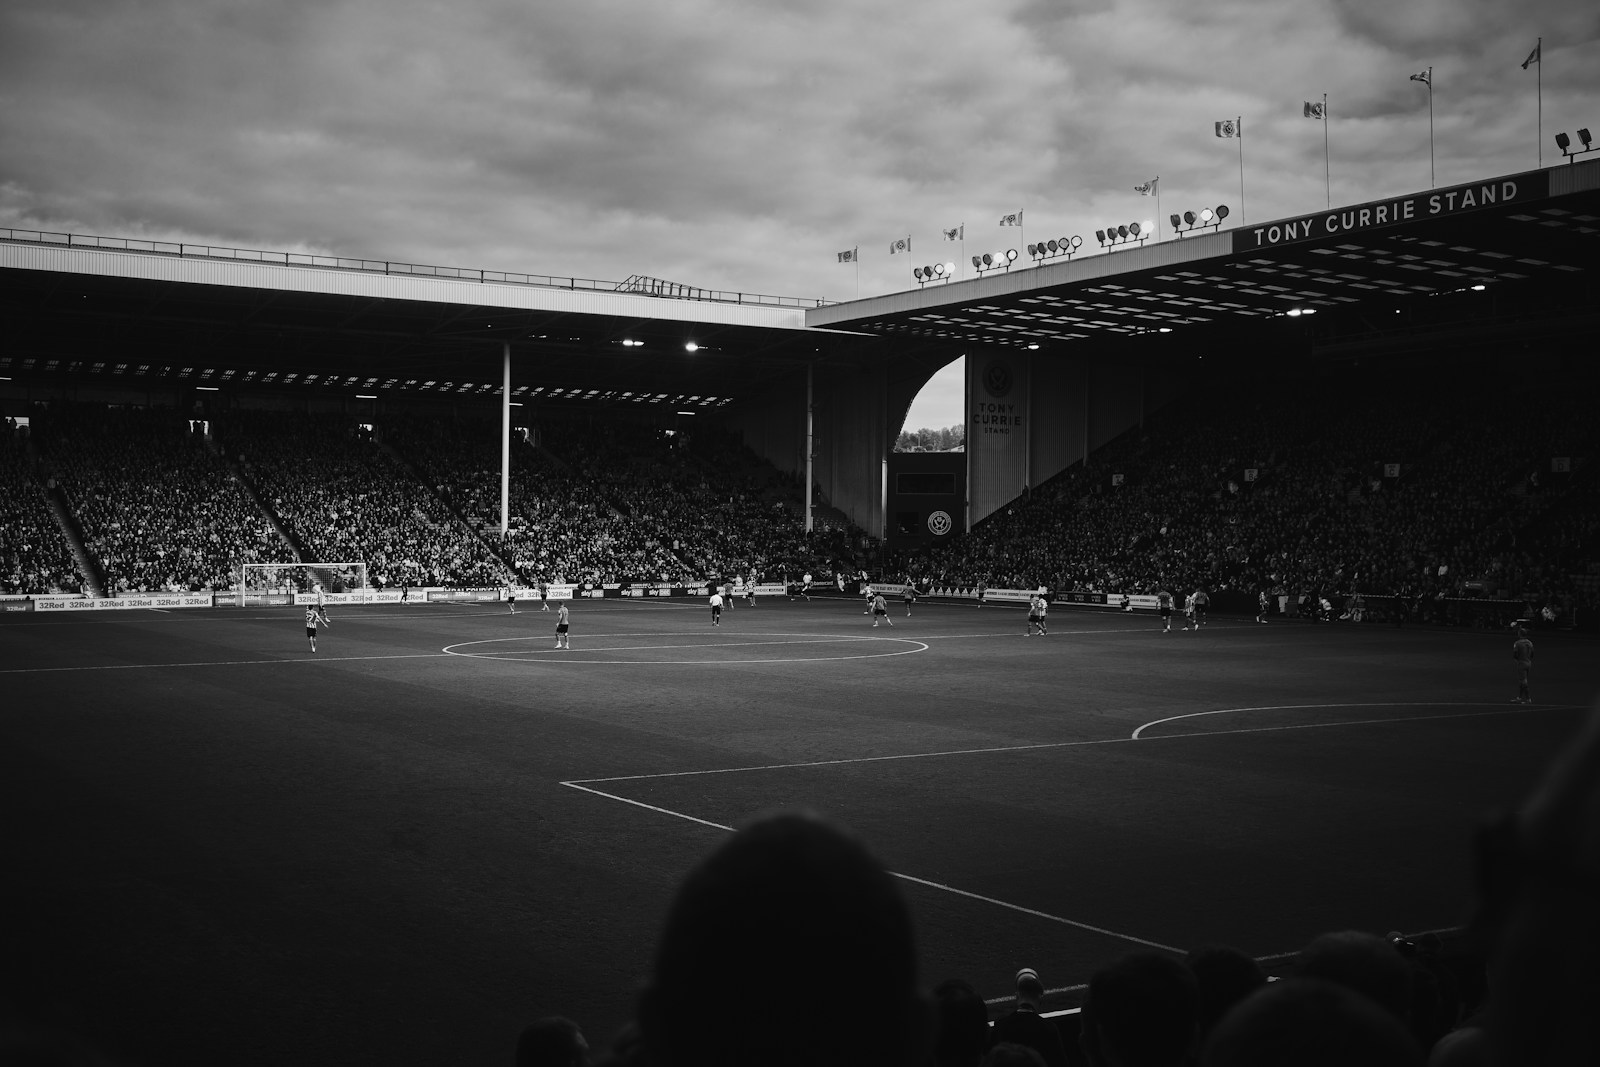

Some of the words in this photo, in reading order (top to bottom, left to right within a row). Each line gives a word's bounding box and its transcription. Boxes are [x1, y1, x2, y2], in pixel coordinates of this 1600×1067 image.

[1254, 219, 1313, 246] TONY
[1325, 200, 1415, 233] CURRIE
[1429, 181, 1518, 214] STAND
[979, 402, 1014, 413] TONY
[973, 414, 1021, 425] CURRIE
[69, 601, 95, 609] 32Red
[99, 600, 124, 608] 32Red
[127, 599, 152, 607] 32Red
